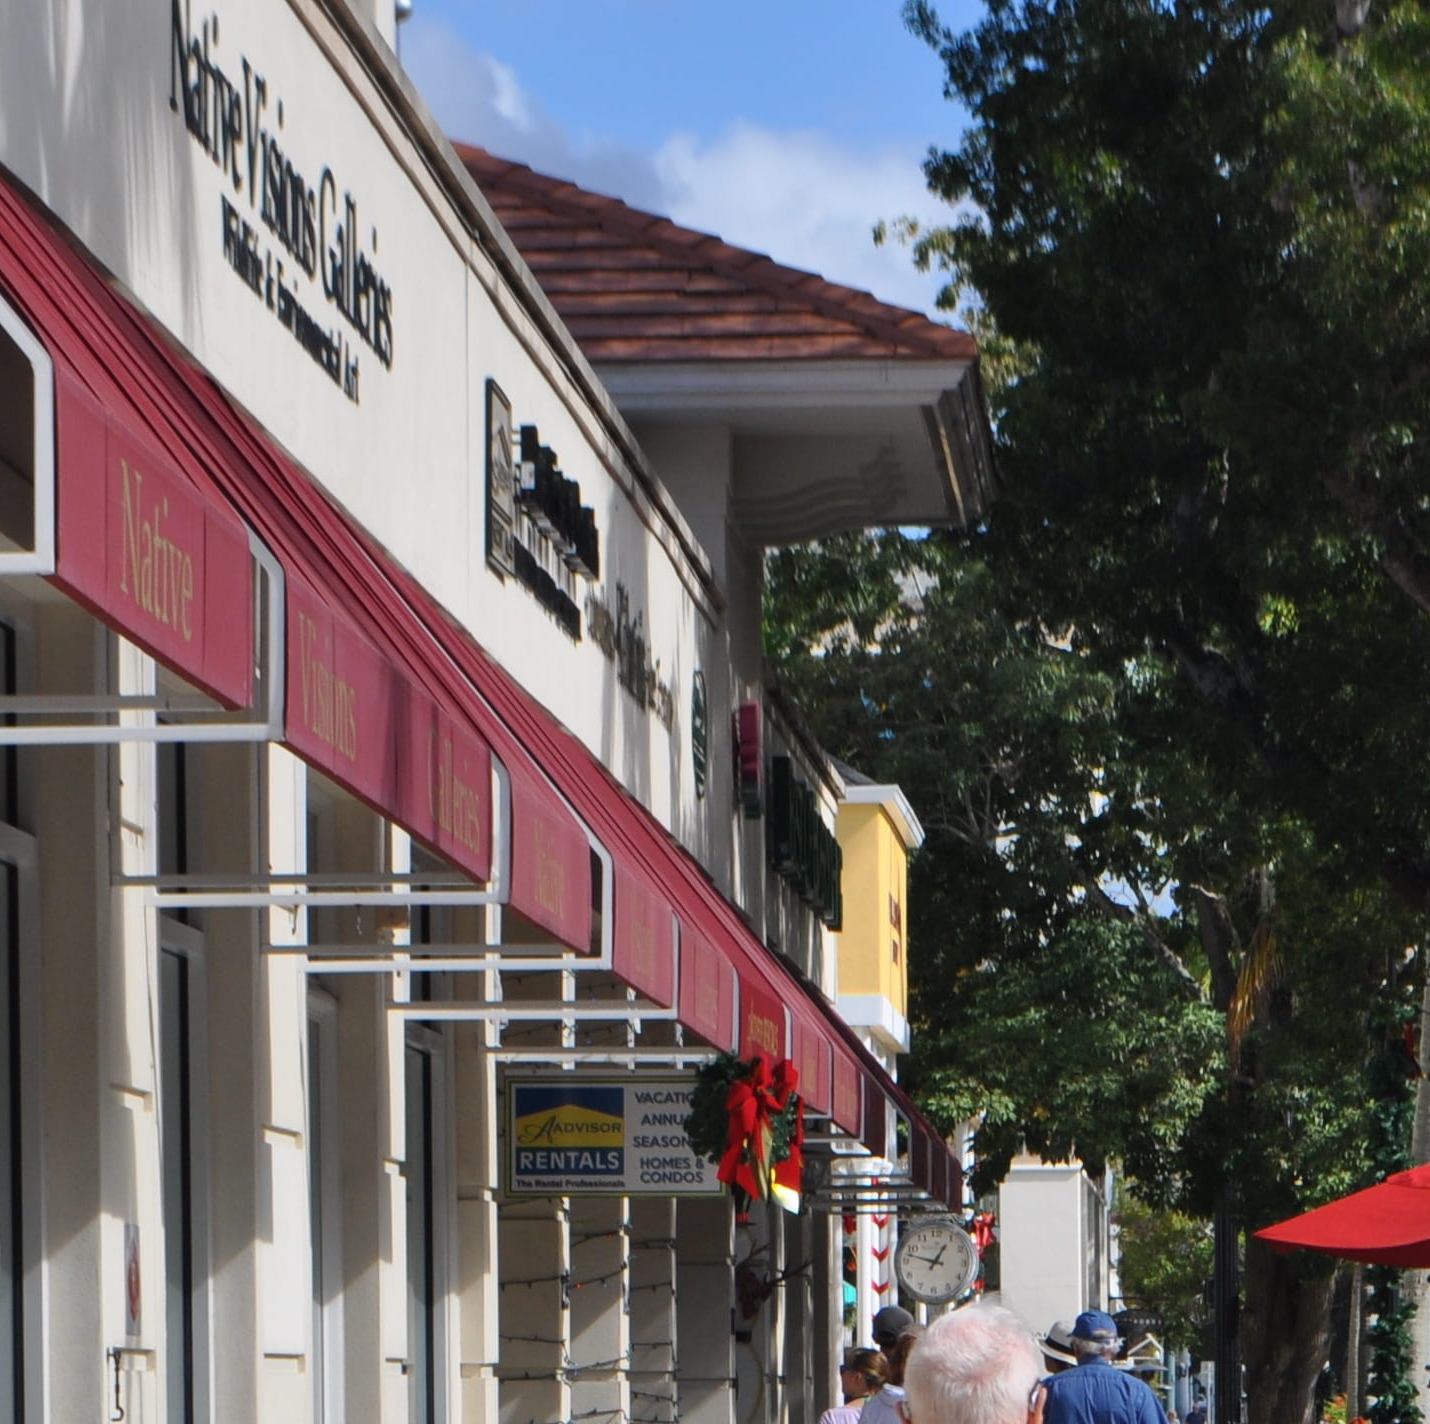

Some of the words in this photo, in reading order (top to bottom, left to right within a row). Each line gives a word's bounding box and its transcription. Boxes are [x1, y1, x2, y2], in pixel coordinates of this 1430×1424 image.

[241, 53, 315, 283] Visions
[319, 165, 393, 373] Galleries
[120, 457, 193, 643] Native
[298, 611, 357, 762] Visions
[427, 724, 481, 858] Galleries
[520, 1151, 620, 1170] RENTALS
[640, 1158, 691, 1170] HOMES
[695, 1158, 704, 1169] &
[640, 1171, 704, 1183] CONDOS
